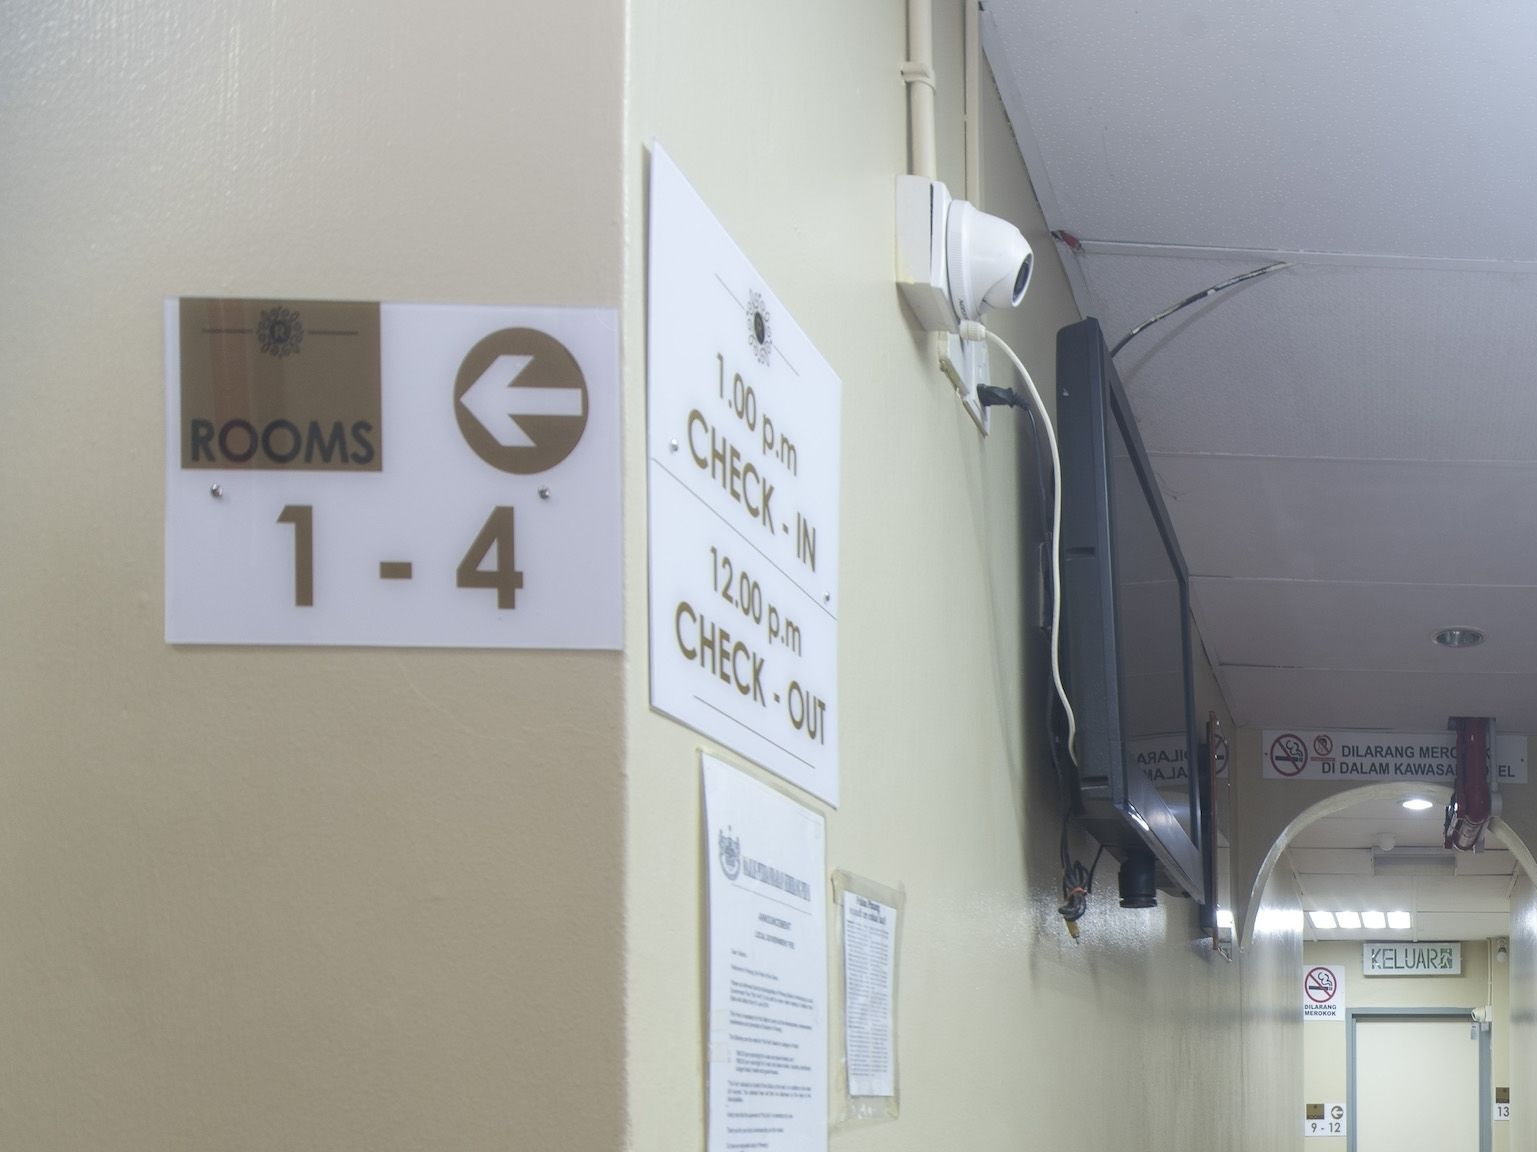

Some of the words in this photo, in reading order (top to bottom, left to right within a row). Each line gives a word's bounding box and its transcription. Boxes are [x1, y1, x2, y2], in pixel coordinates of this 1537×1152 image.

[716, 352, 757, 432] 1.00
[762, 412, 798, 477] p.m
[190, 418, 375, 466] ROOMS
[687, 408, 775, 535] CHECK
[796, 511, 817, 573] IN
[276, 504, 313, 607] 1
[455, 505, 524, 610] 4
[710, 546, 763, 625] 12.00
[767, 602, 802, 658] p.m
[674, 600, 766, 708] CHECK
[787, 679, 826, 745] OUT
[1321, 762, 1336, 775] DI
[1339, 762, 1390, 776] DALAM
[1393, 762, 1457, 777] KAWASA
[1341, 745, 1415, 759] DILARANG
[1371, 948, 1438, 969] KELUAR
[1311, 1122, 1318, 1134] 9
[1328, 1122, 1342, 1134] 12
[1497, 1106, 1510, 1118] 13
